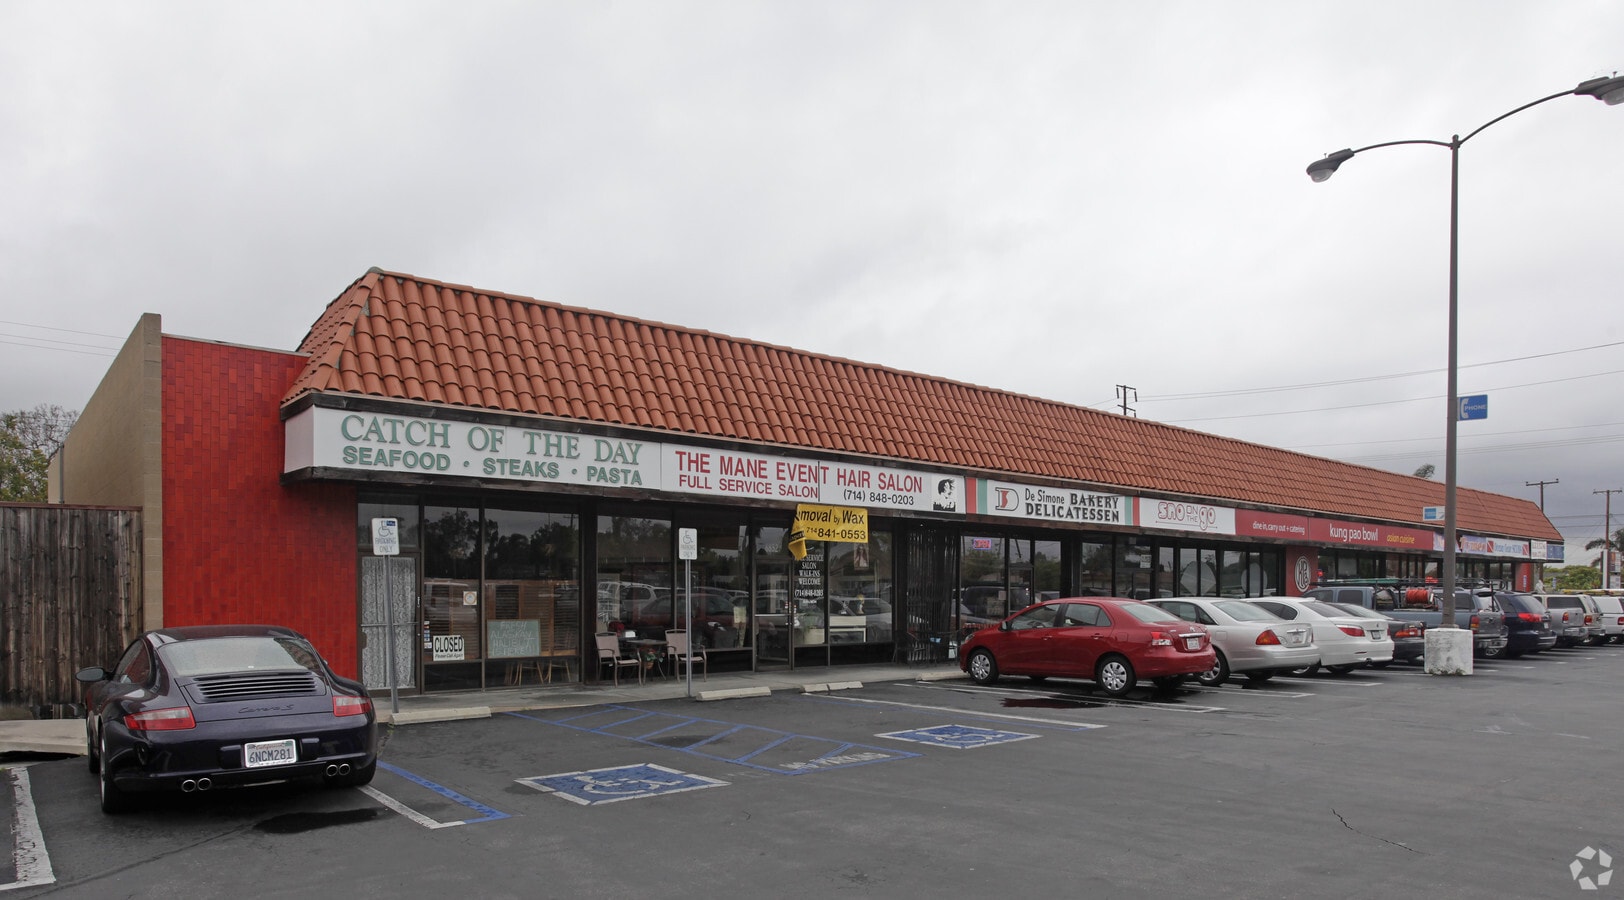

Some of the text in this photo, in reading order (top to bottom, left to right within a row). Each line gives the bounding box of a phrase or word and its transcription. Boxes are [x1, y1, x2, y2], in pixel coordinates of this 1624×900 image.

[341, 414, 643, 465] CATCH OF THE DAY
[342, 445, 643, 486] SEAFOOD STEAKS PASTA
[675, 450, 923, 493] THE MANE EVENT HAIR SALON
[679, 474, 819, 499] FULL SERVICE SALON
[843, 488, 914, 506] (714) 848-0203
[1025, 488, 1119, 509] De Simone BAKERY
[834, 516, 841, 525] by
[843, 510, 865, 525] Wax
[1026, 502, 1120, 523] DELICATESSEN
[1186, 505, 1199, 515] ON
[1186, 514, 1199, 523] THE
[1252, 521, 1262, 530] dine
[806, 526, 866, 540] 714 841-0553
[1329, 523, 1379, 542] kung pao bowl
[1387, 533, 1400, 542] asian
[379, 545, 393, 553] ONLY
[802, 561, 817, 569] SALON
[798, 577, 821, 586] WELCOME
[434, 636, 463, 653] CLOSED
[249, 748, 293, 763] 6NCM281
